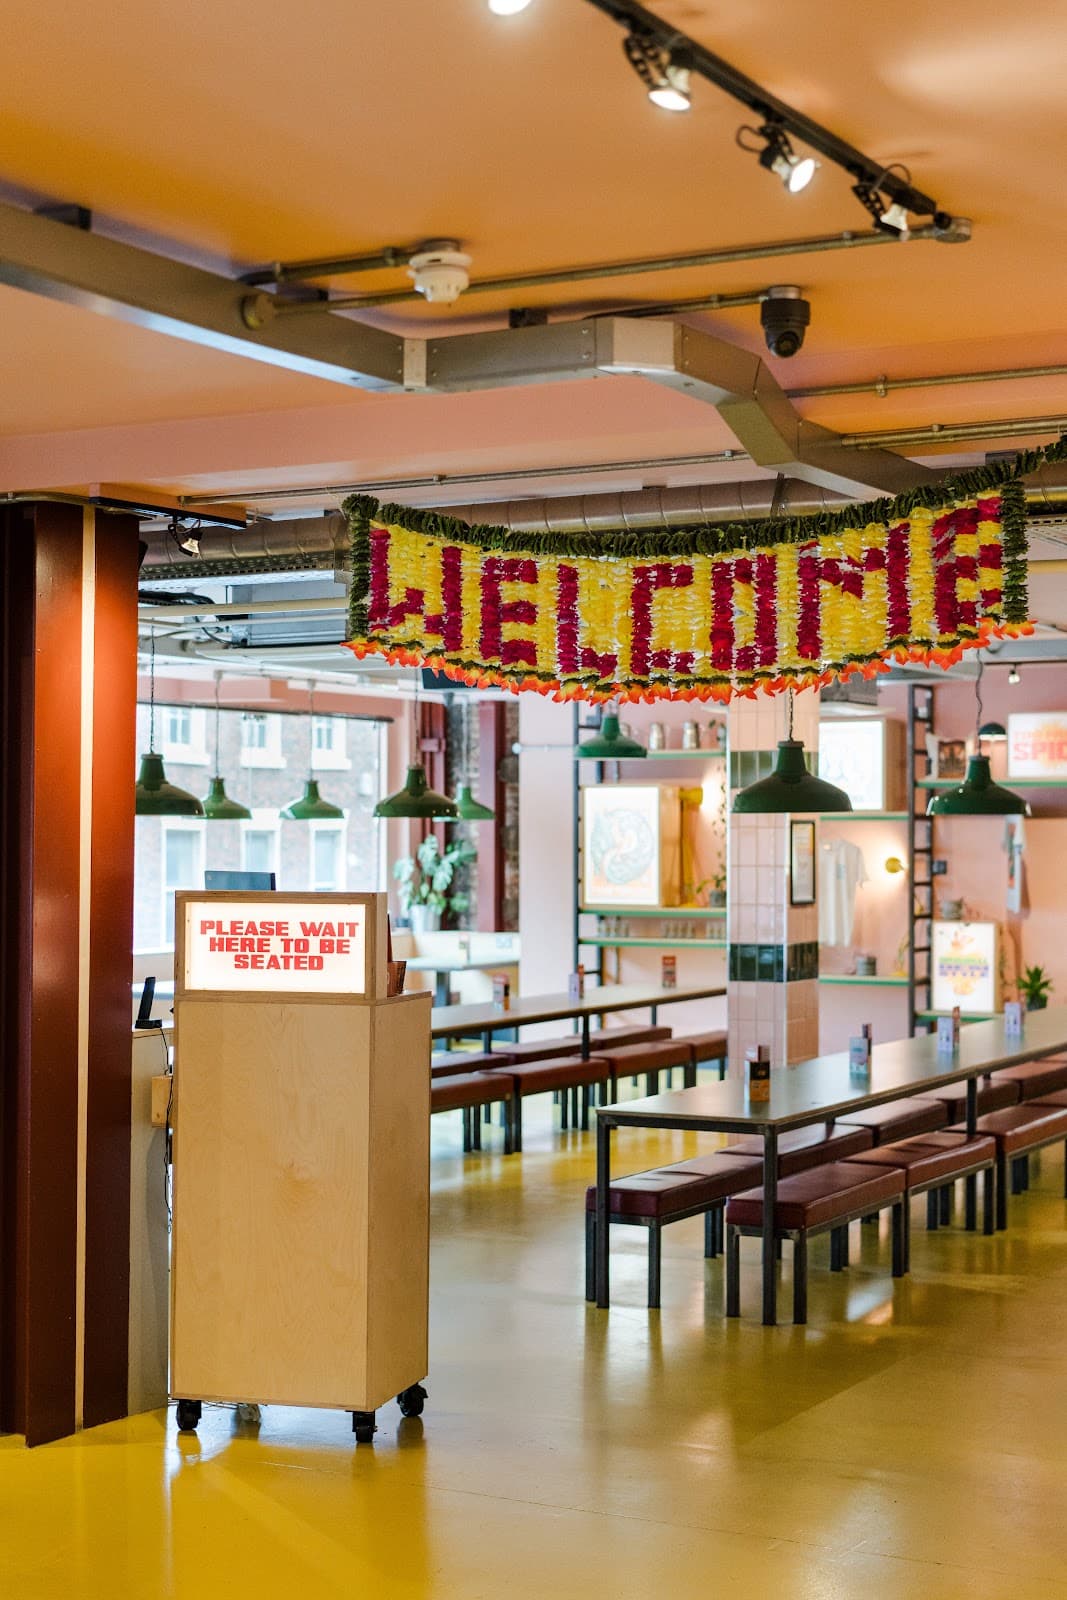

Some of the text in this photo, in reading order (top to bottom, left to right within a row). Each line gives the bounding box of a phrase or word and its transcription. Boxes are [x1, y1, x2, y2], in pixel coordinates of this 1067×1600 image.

[368, 496, 1002, 677] WELCOME
[200, 920, 359, 937] PLEASE WAIT
[209, 937, 350, 954] HERE TO BE
[234, 954, 324, 970] SEATED
